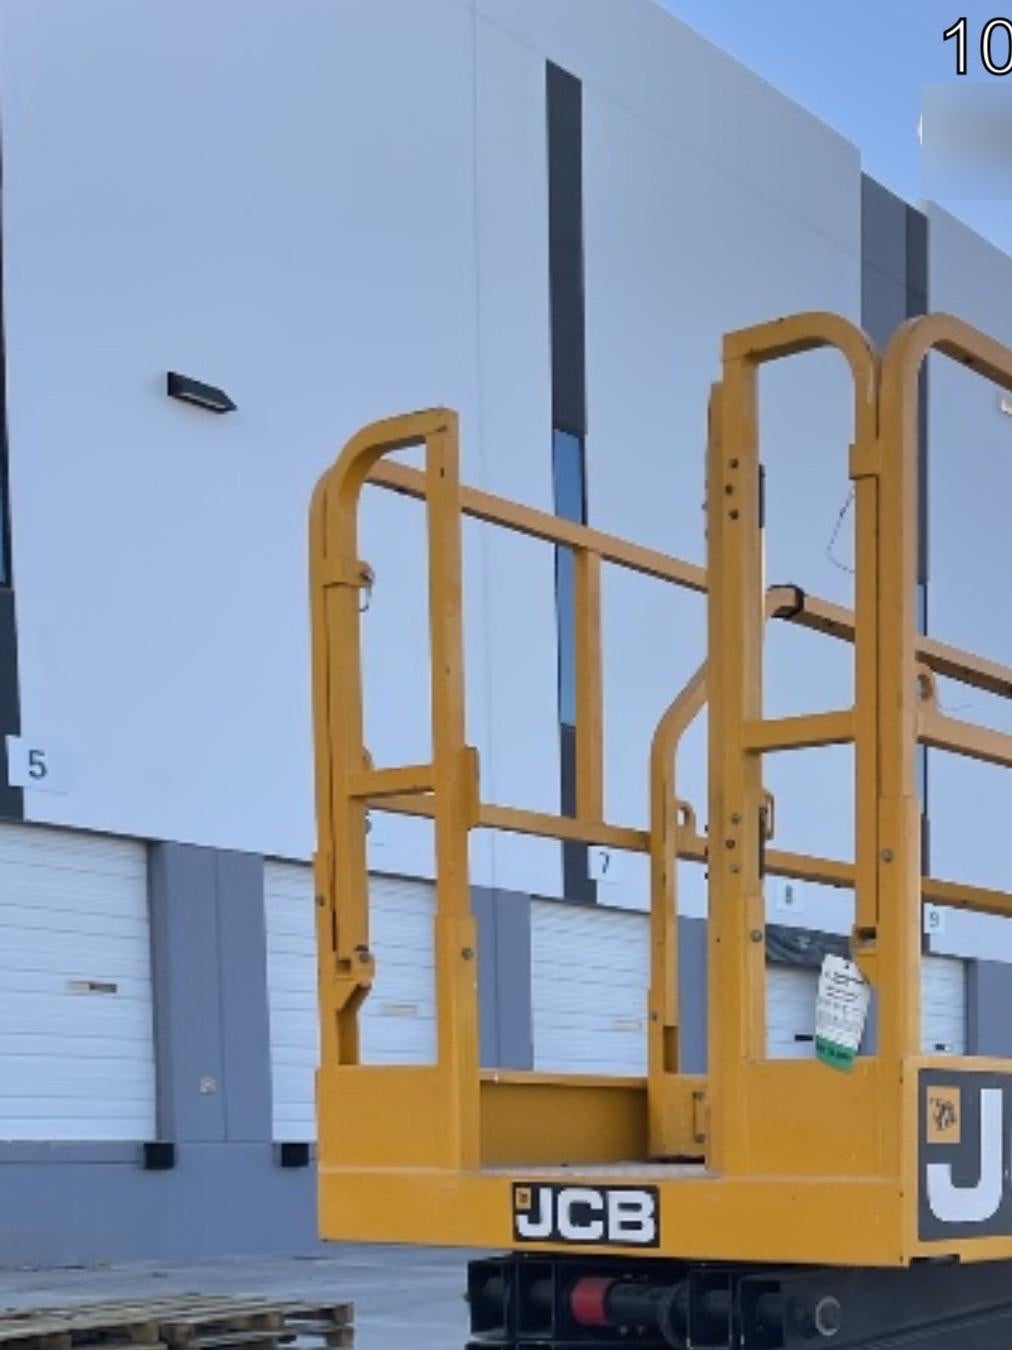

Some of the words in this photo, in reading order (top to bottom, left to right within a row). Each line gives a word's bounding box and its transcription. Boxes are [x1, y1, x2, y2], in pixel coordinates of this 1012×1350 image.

[29, 749, 47, 780] 5
[928, 911, 939, 928] 9
[515, 1187, 655, 1243] JCB
